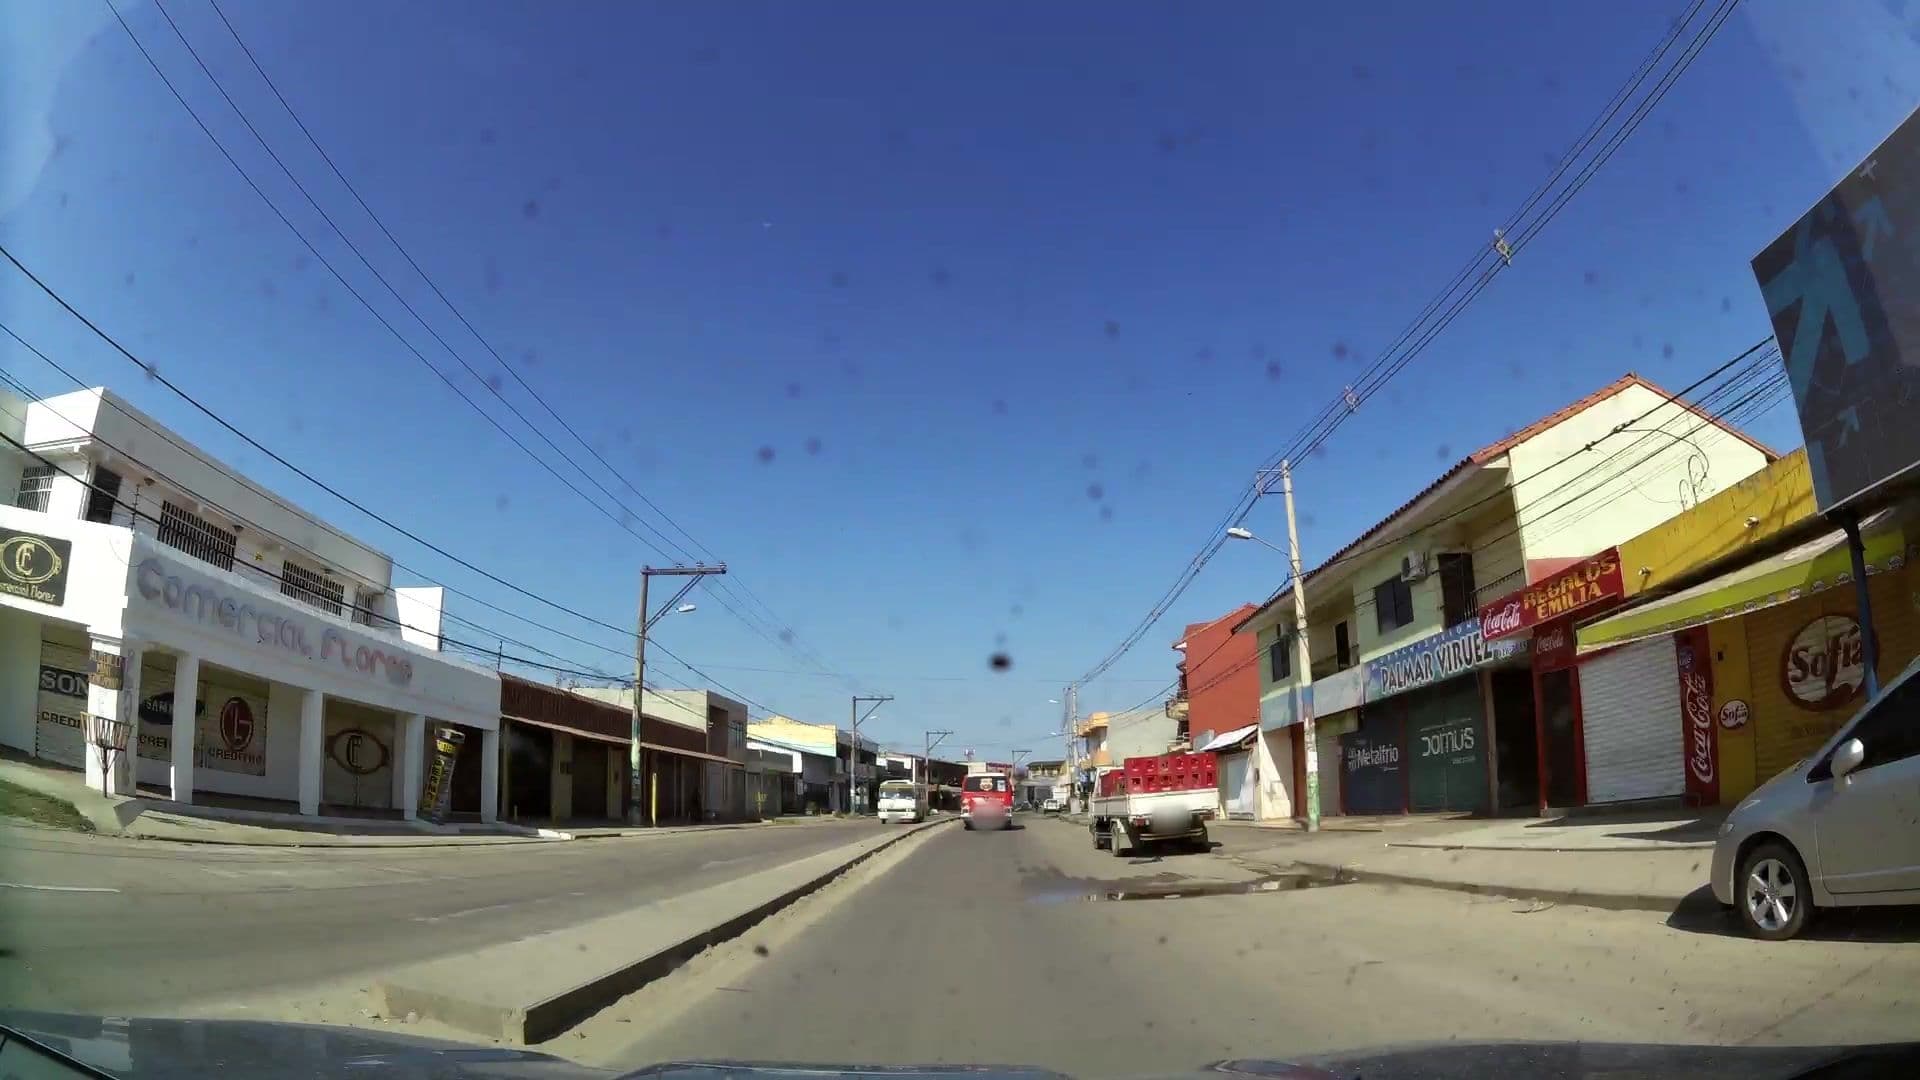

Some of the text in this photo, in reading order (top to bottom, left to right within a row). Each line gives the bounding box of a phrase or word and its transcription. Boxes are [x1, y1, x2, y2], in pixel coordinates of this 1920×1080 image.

[1536, 580, 1602, 619] EMILIA
[1380, 650, 1434, 695] PALMAR
[1434, 632, 1494, 678] VIRUEZ
